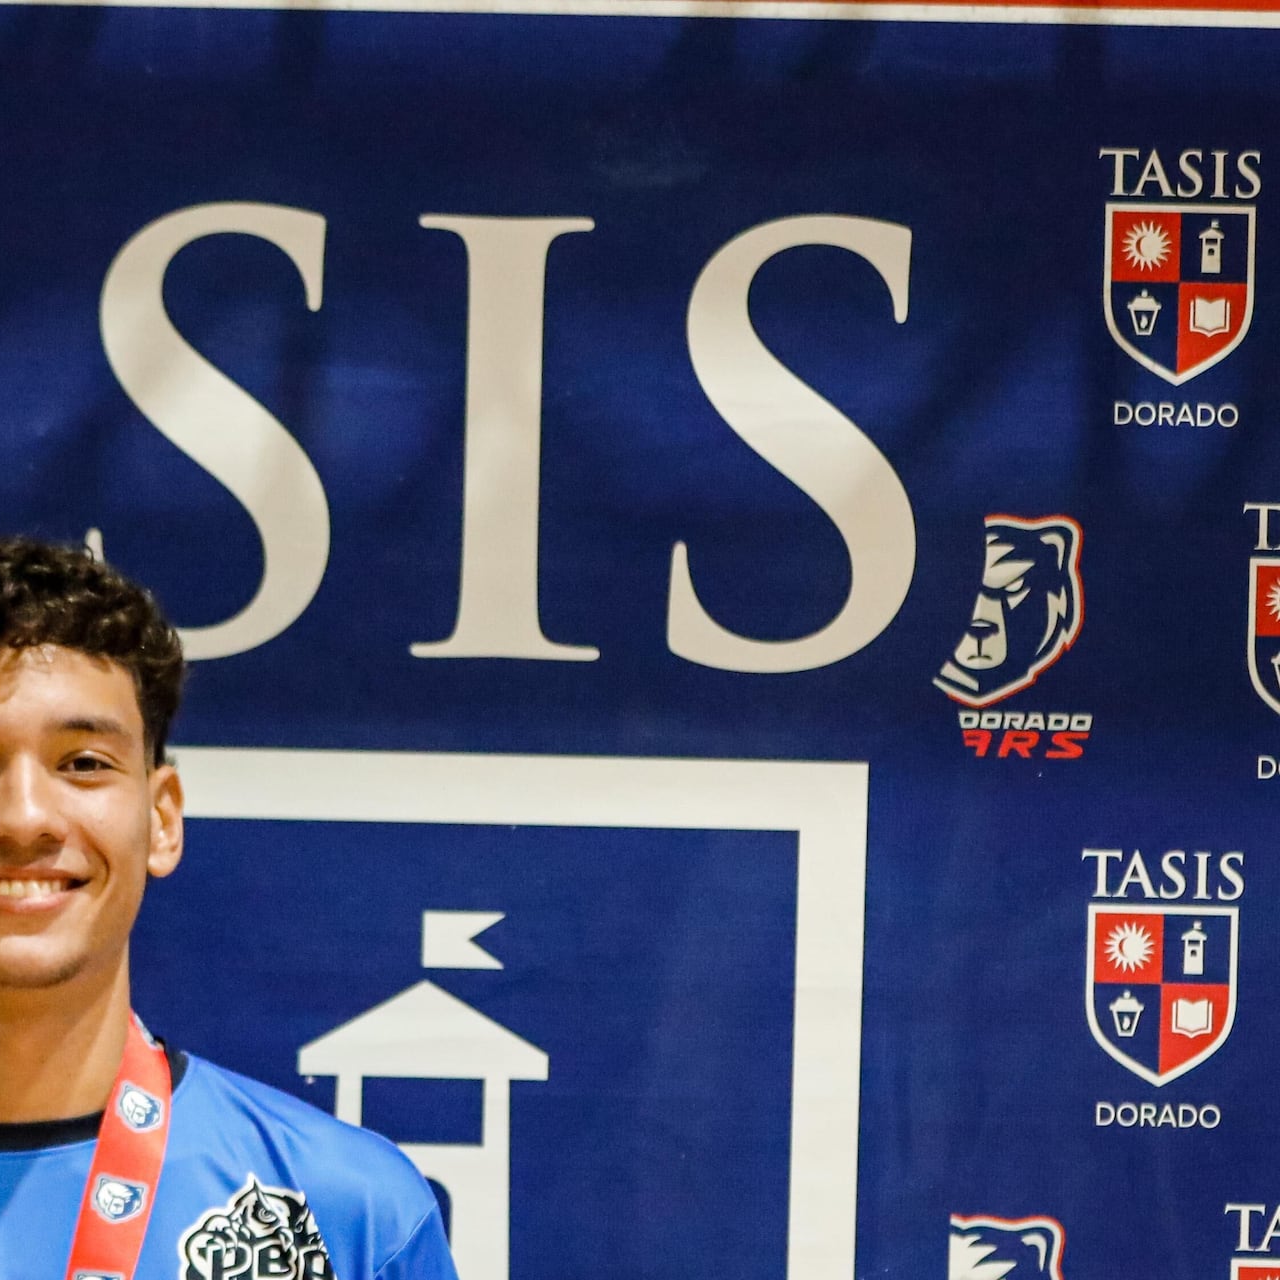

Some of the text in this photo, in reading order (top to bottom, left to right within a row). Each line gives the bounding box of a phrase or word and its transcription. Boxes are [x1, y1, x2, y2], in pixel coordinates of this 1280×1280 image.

[1099, 147, 1262, 199] TASIS
[1113, 401, 1239, 428] DORADO
[958, 711, 1093, 731] DORADO
[1081, 848, 1245, 901] TASIS
[1095, 1101, 1221, 1129] DORADO
